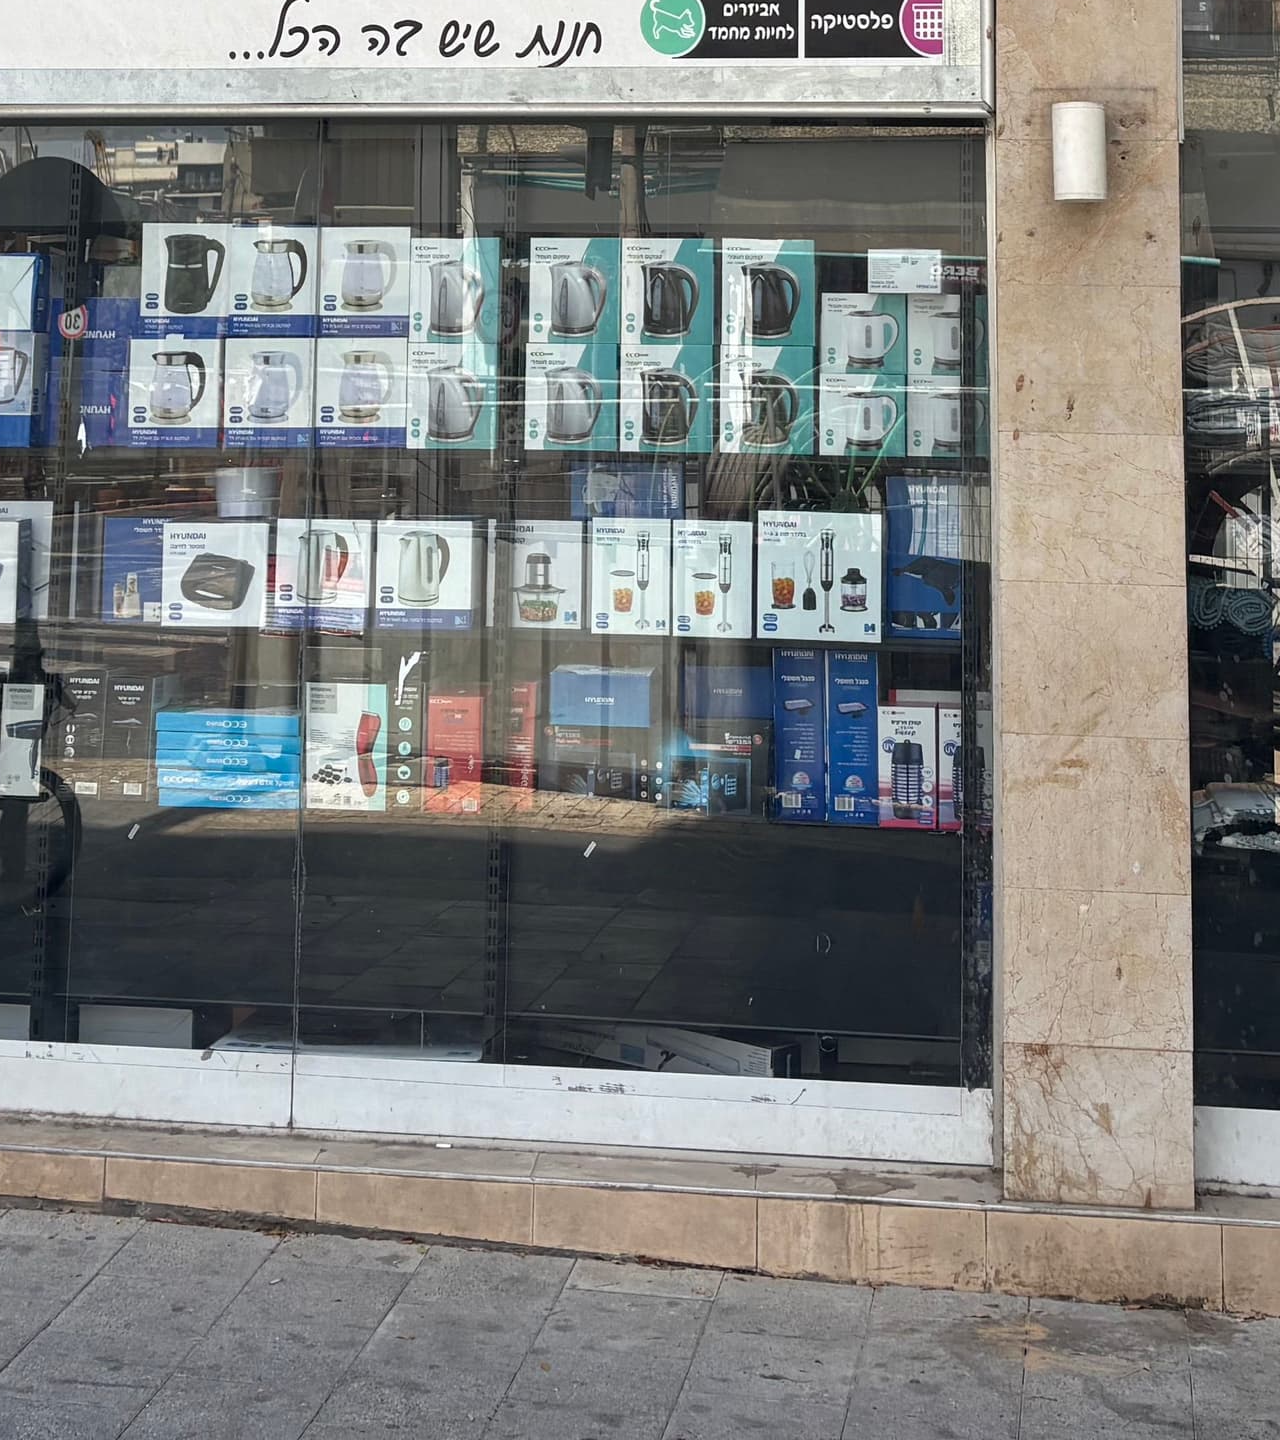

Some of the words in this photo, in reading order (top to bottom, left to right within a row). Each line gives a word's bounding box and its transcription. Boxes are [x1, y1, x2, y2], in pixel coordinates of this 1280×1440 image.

[723, 2, 781, 19] אביזרים
[756, 21, 795, 41] לחיות
[810, 12, 894, 33] פלסטיקה
[361, 19, 423, 59] בה
[439, 21, 501, 58] שיש
[516, 19, 603, 68] חנות
[707, 26, 751, 42] מחמד
[169, 531, 206, 540] HYUNDAI
[69, 677, 100, 685] HYUNDAI
